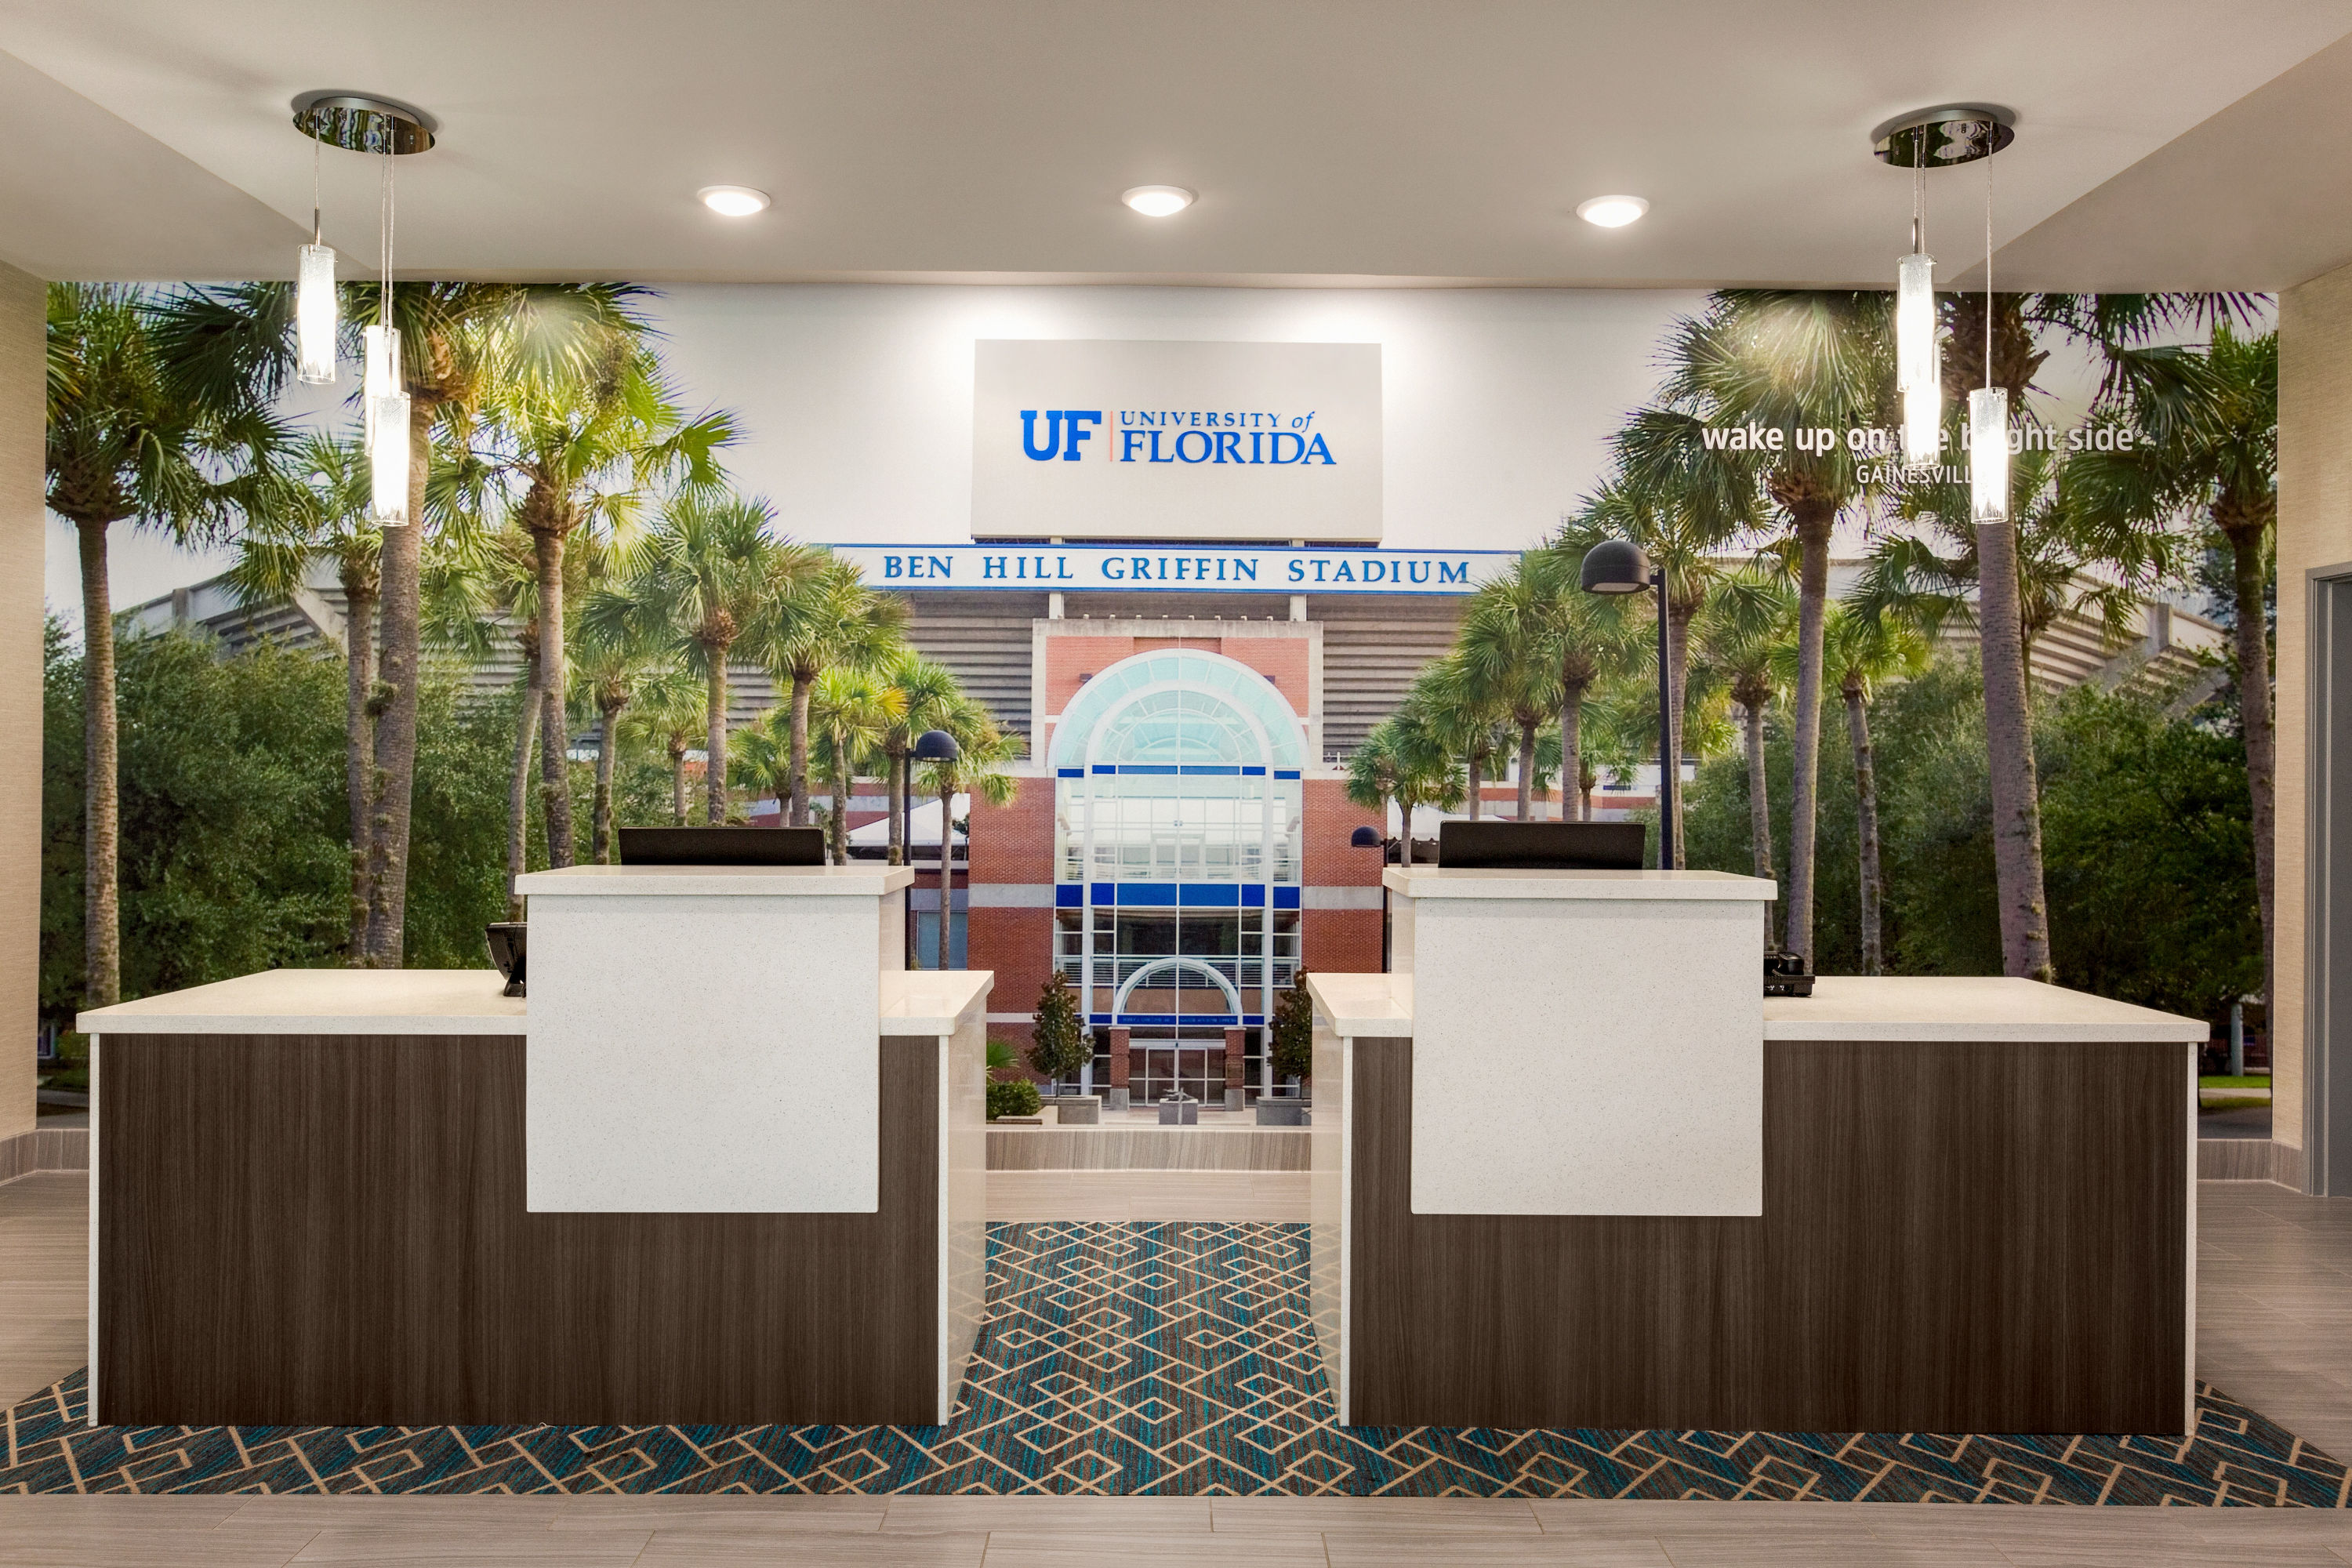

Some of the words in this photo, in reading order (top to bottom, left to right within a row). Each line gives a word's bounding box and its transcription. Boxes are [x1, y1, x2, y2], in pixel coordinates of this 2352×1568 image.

[1020, 409, 1102, 462] UF
[1120, 410, 1281, 428] UNIVERSITY
[1291, 411, 1316, 433] of
[1119, 429, 1338, 466] FLORIDA
[1701, 422, 1784, 451] wake
[1796, 427, 1835, 457] up
[1847, 427, 1886, 452] on
[1897, 423, 1949, 452] te
[1961, 422, 2058, 455] bght
[1856, 464, 1972, 485] GAINESVILL
[883, 555, 953, 579] BEN
[982, 556, 1074, 579] HILL
[1101, 557, 1258, 581] GRIFFIN
[1287, 559, 1469, 584] STADIUM
